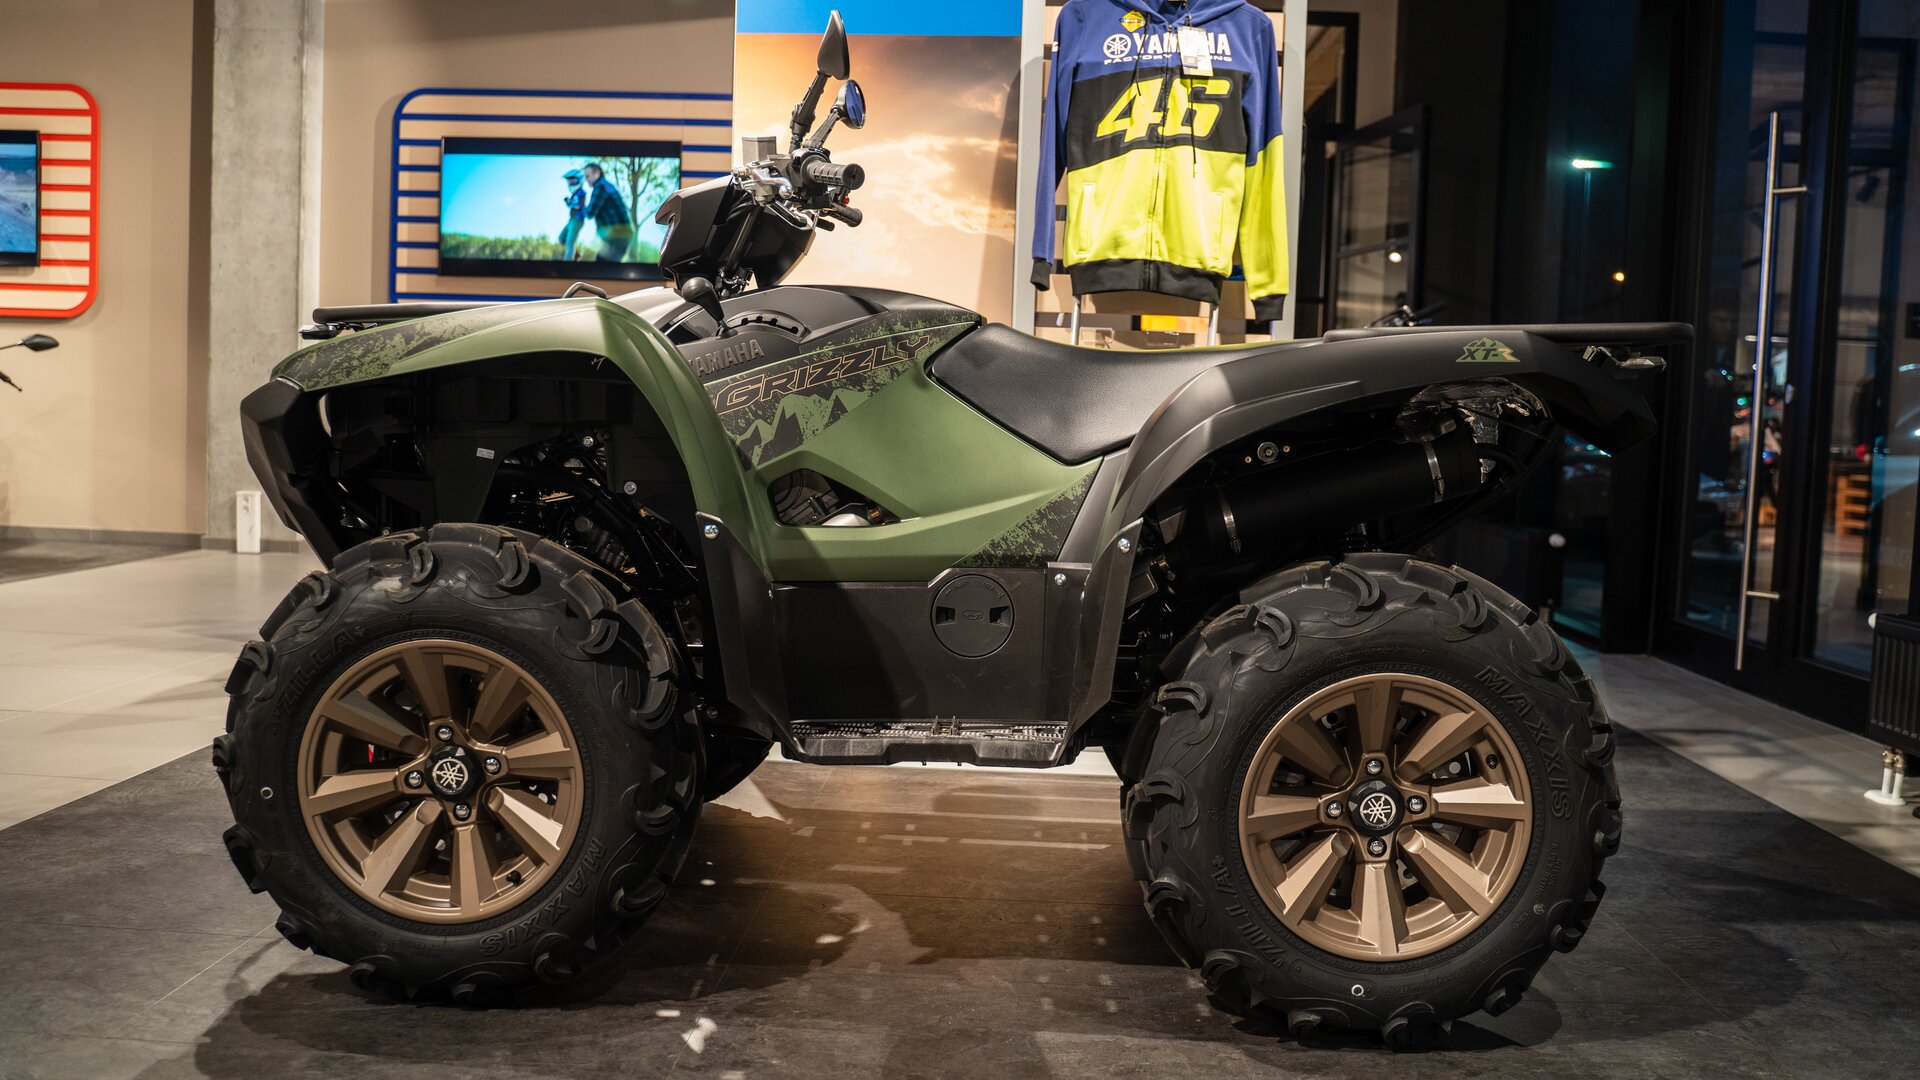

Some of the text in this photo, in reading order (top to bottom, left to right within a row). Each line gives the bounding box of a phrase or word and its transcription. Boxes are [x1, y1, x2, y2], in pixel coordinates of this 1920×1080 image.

[1104, 54, 1173, 65] FACTORY
[1096, 77, 1232, 143] 46
[688, 339, 765, 377] AMAHA
[715, 335, 930, 415] GRIZZLY
[1473, 664, 1573, 819] MAXXIS
[480, 838, 607, 956] MAXXIS
